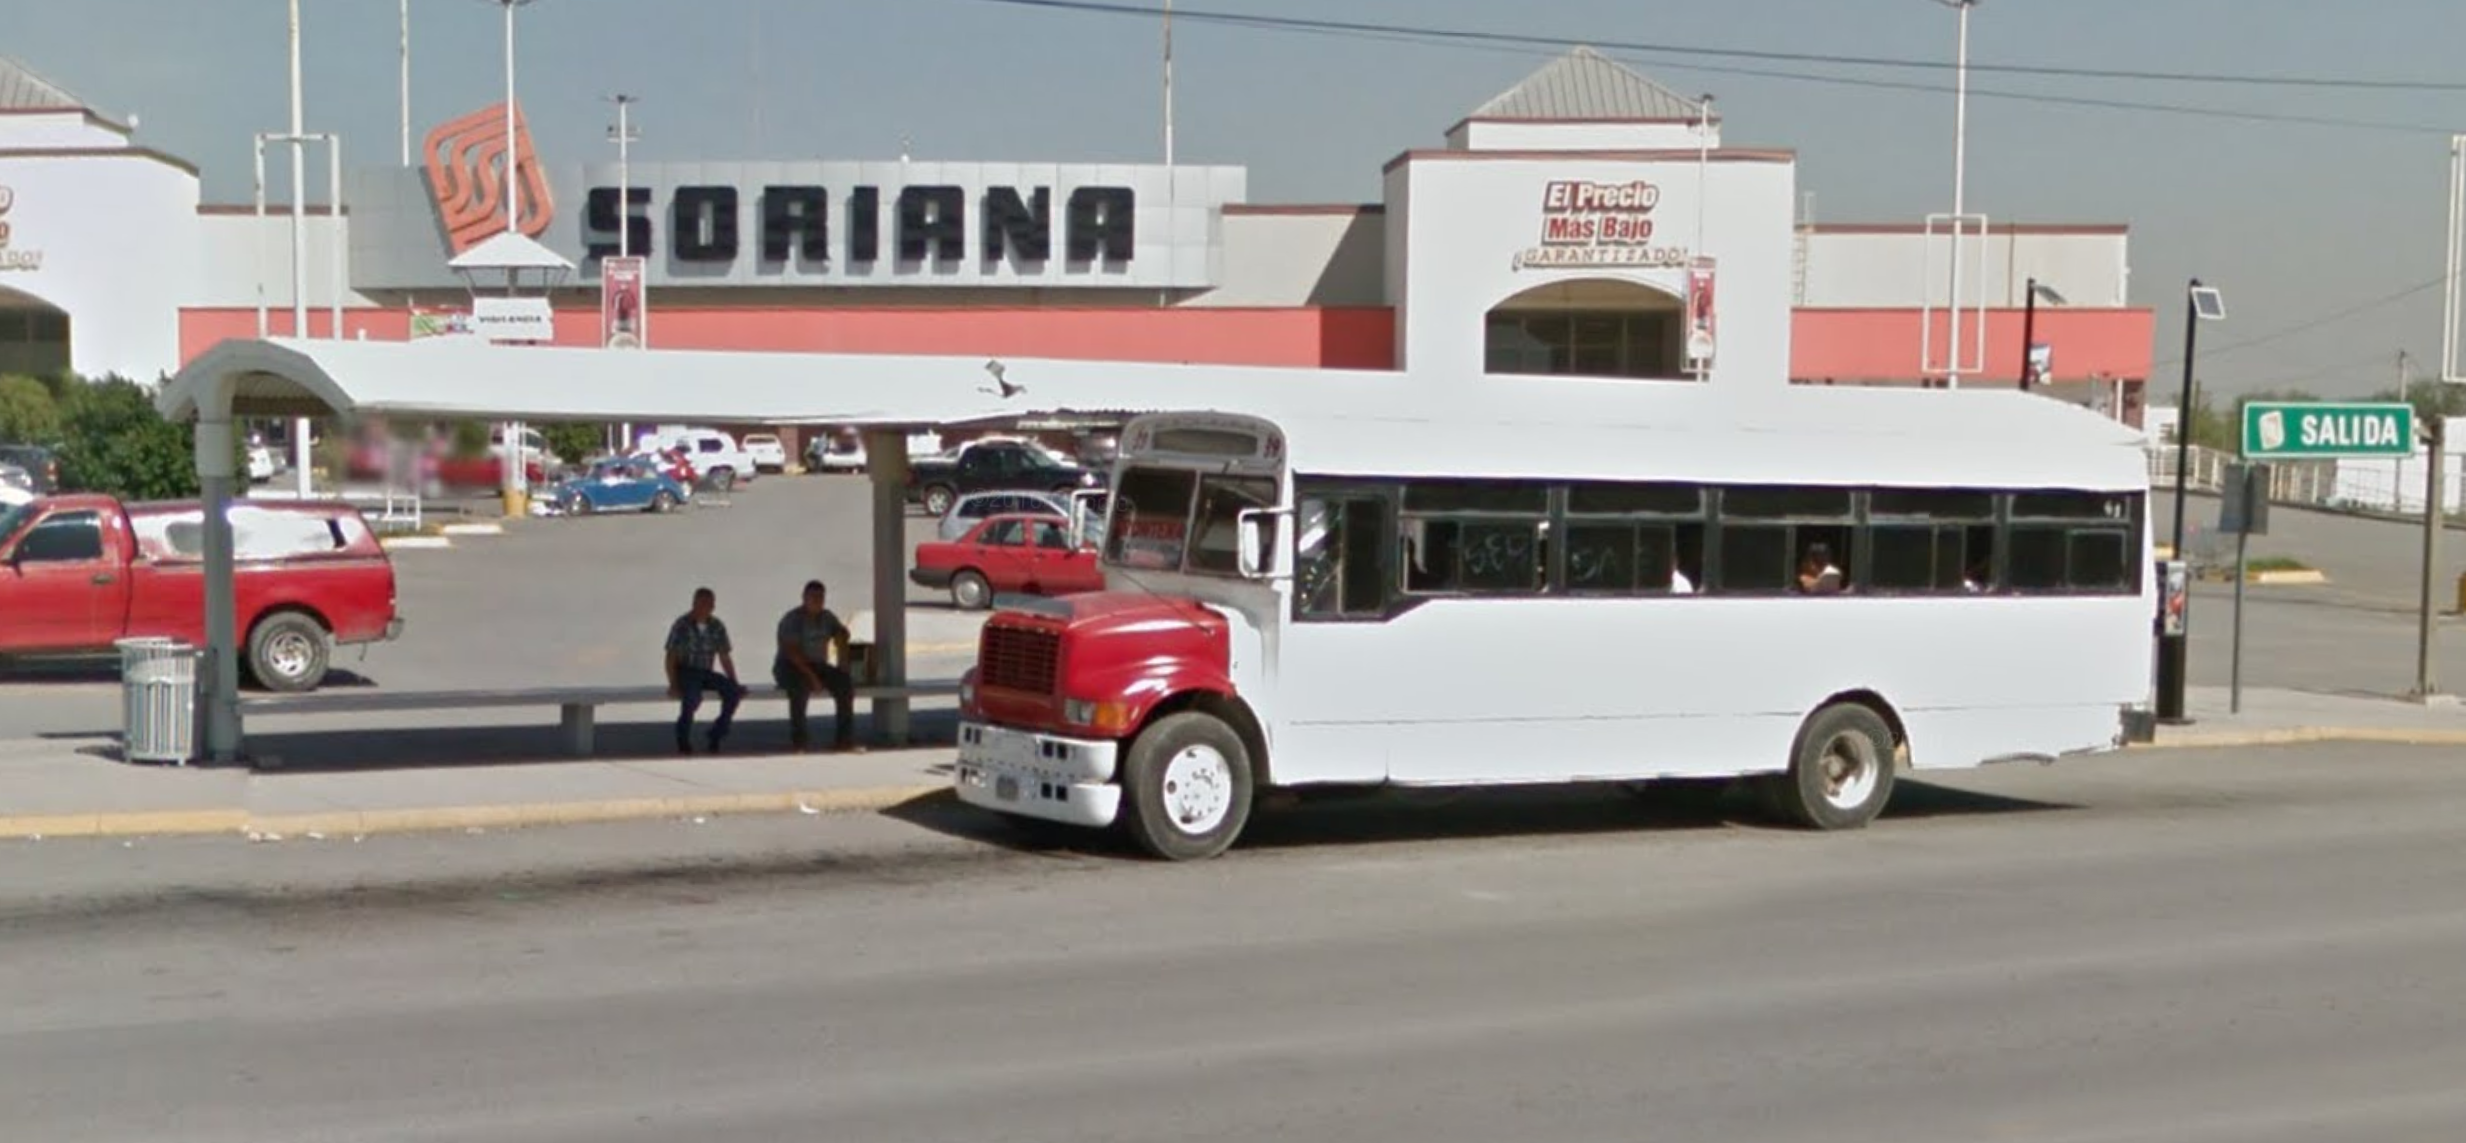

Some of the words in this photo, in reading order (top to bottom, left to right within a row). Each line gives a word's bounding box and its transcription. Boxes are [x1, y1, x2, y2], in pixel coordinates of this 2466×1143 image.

[1545, 182, 1571, 209] El
[1576, 181, 1658, 210] Precio
[588, 185, 1135, 261] SORIANA
[1602, 216, 1654, 240] Bajo
[2300, 414, 2399, 446] SALIDA
